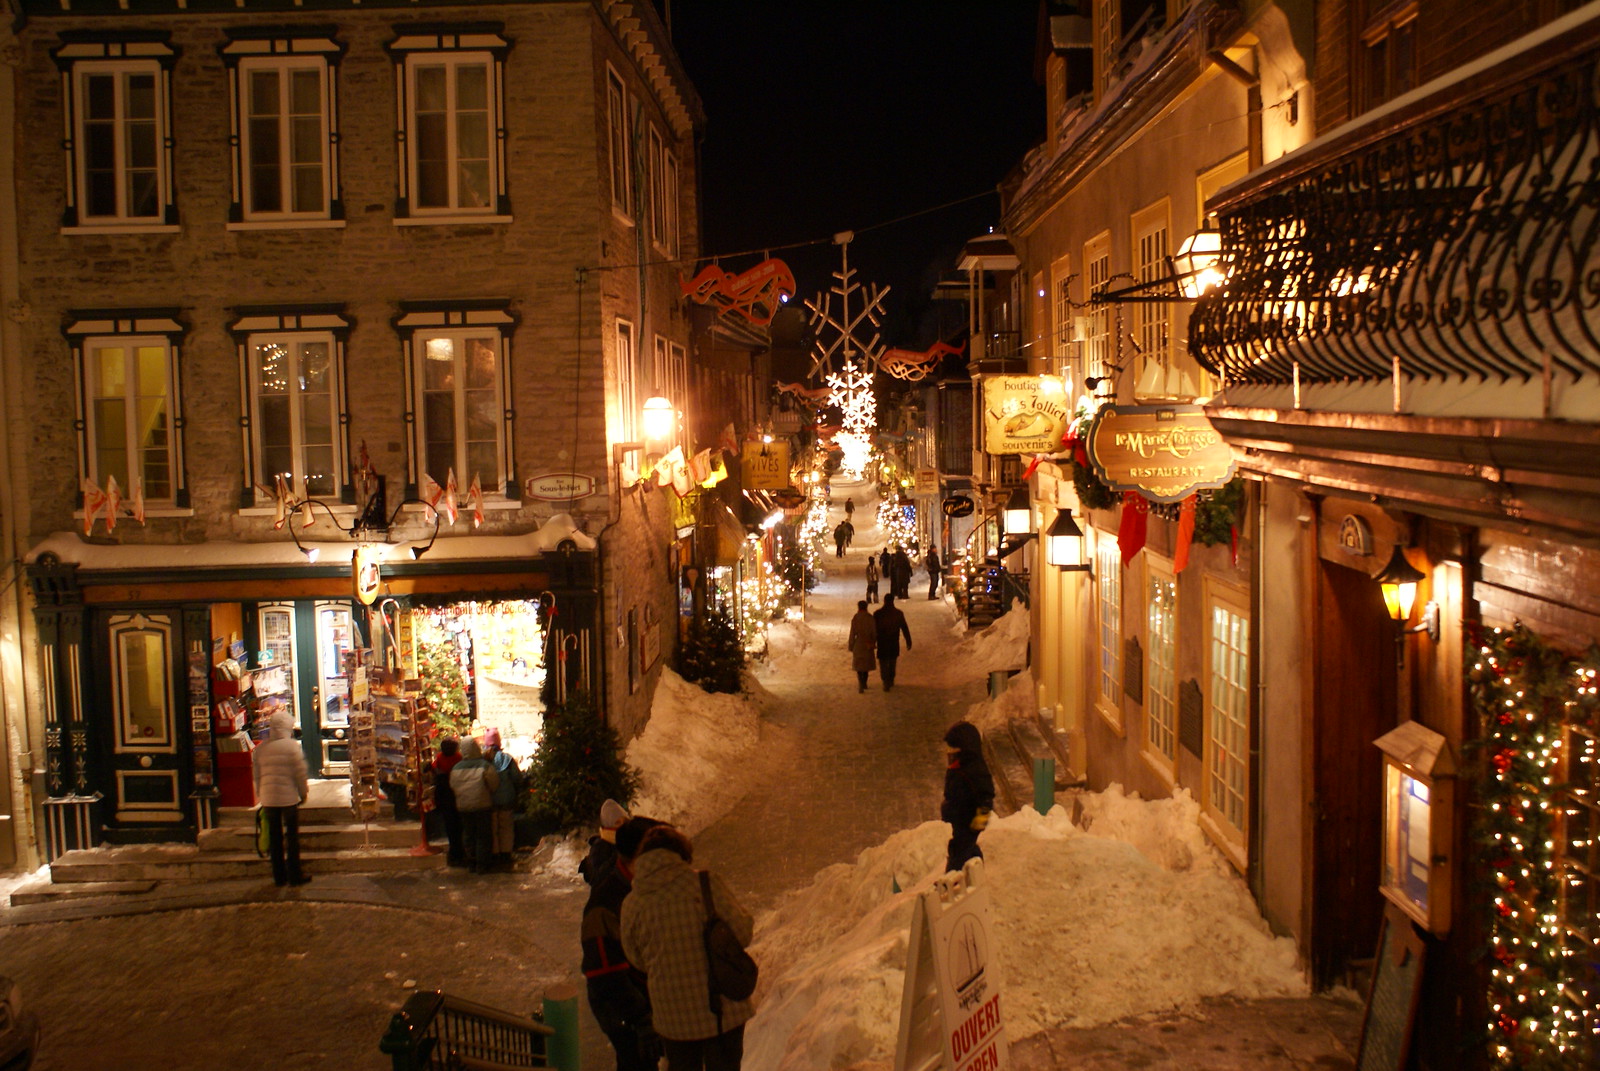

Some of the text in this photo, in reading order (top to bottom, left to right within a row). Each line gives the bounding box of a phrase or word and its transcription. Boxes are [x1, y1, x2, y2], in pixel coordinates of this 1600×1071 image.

[1002, 438, 1053, 450] souvenirs
[1129, 465, 1205, 478] RESTAURANT
[952, 993, 1000, 1062] OUVERT
